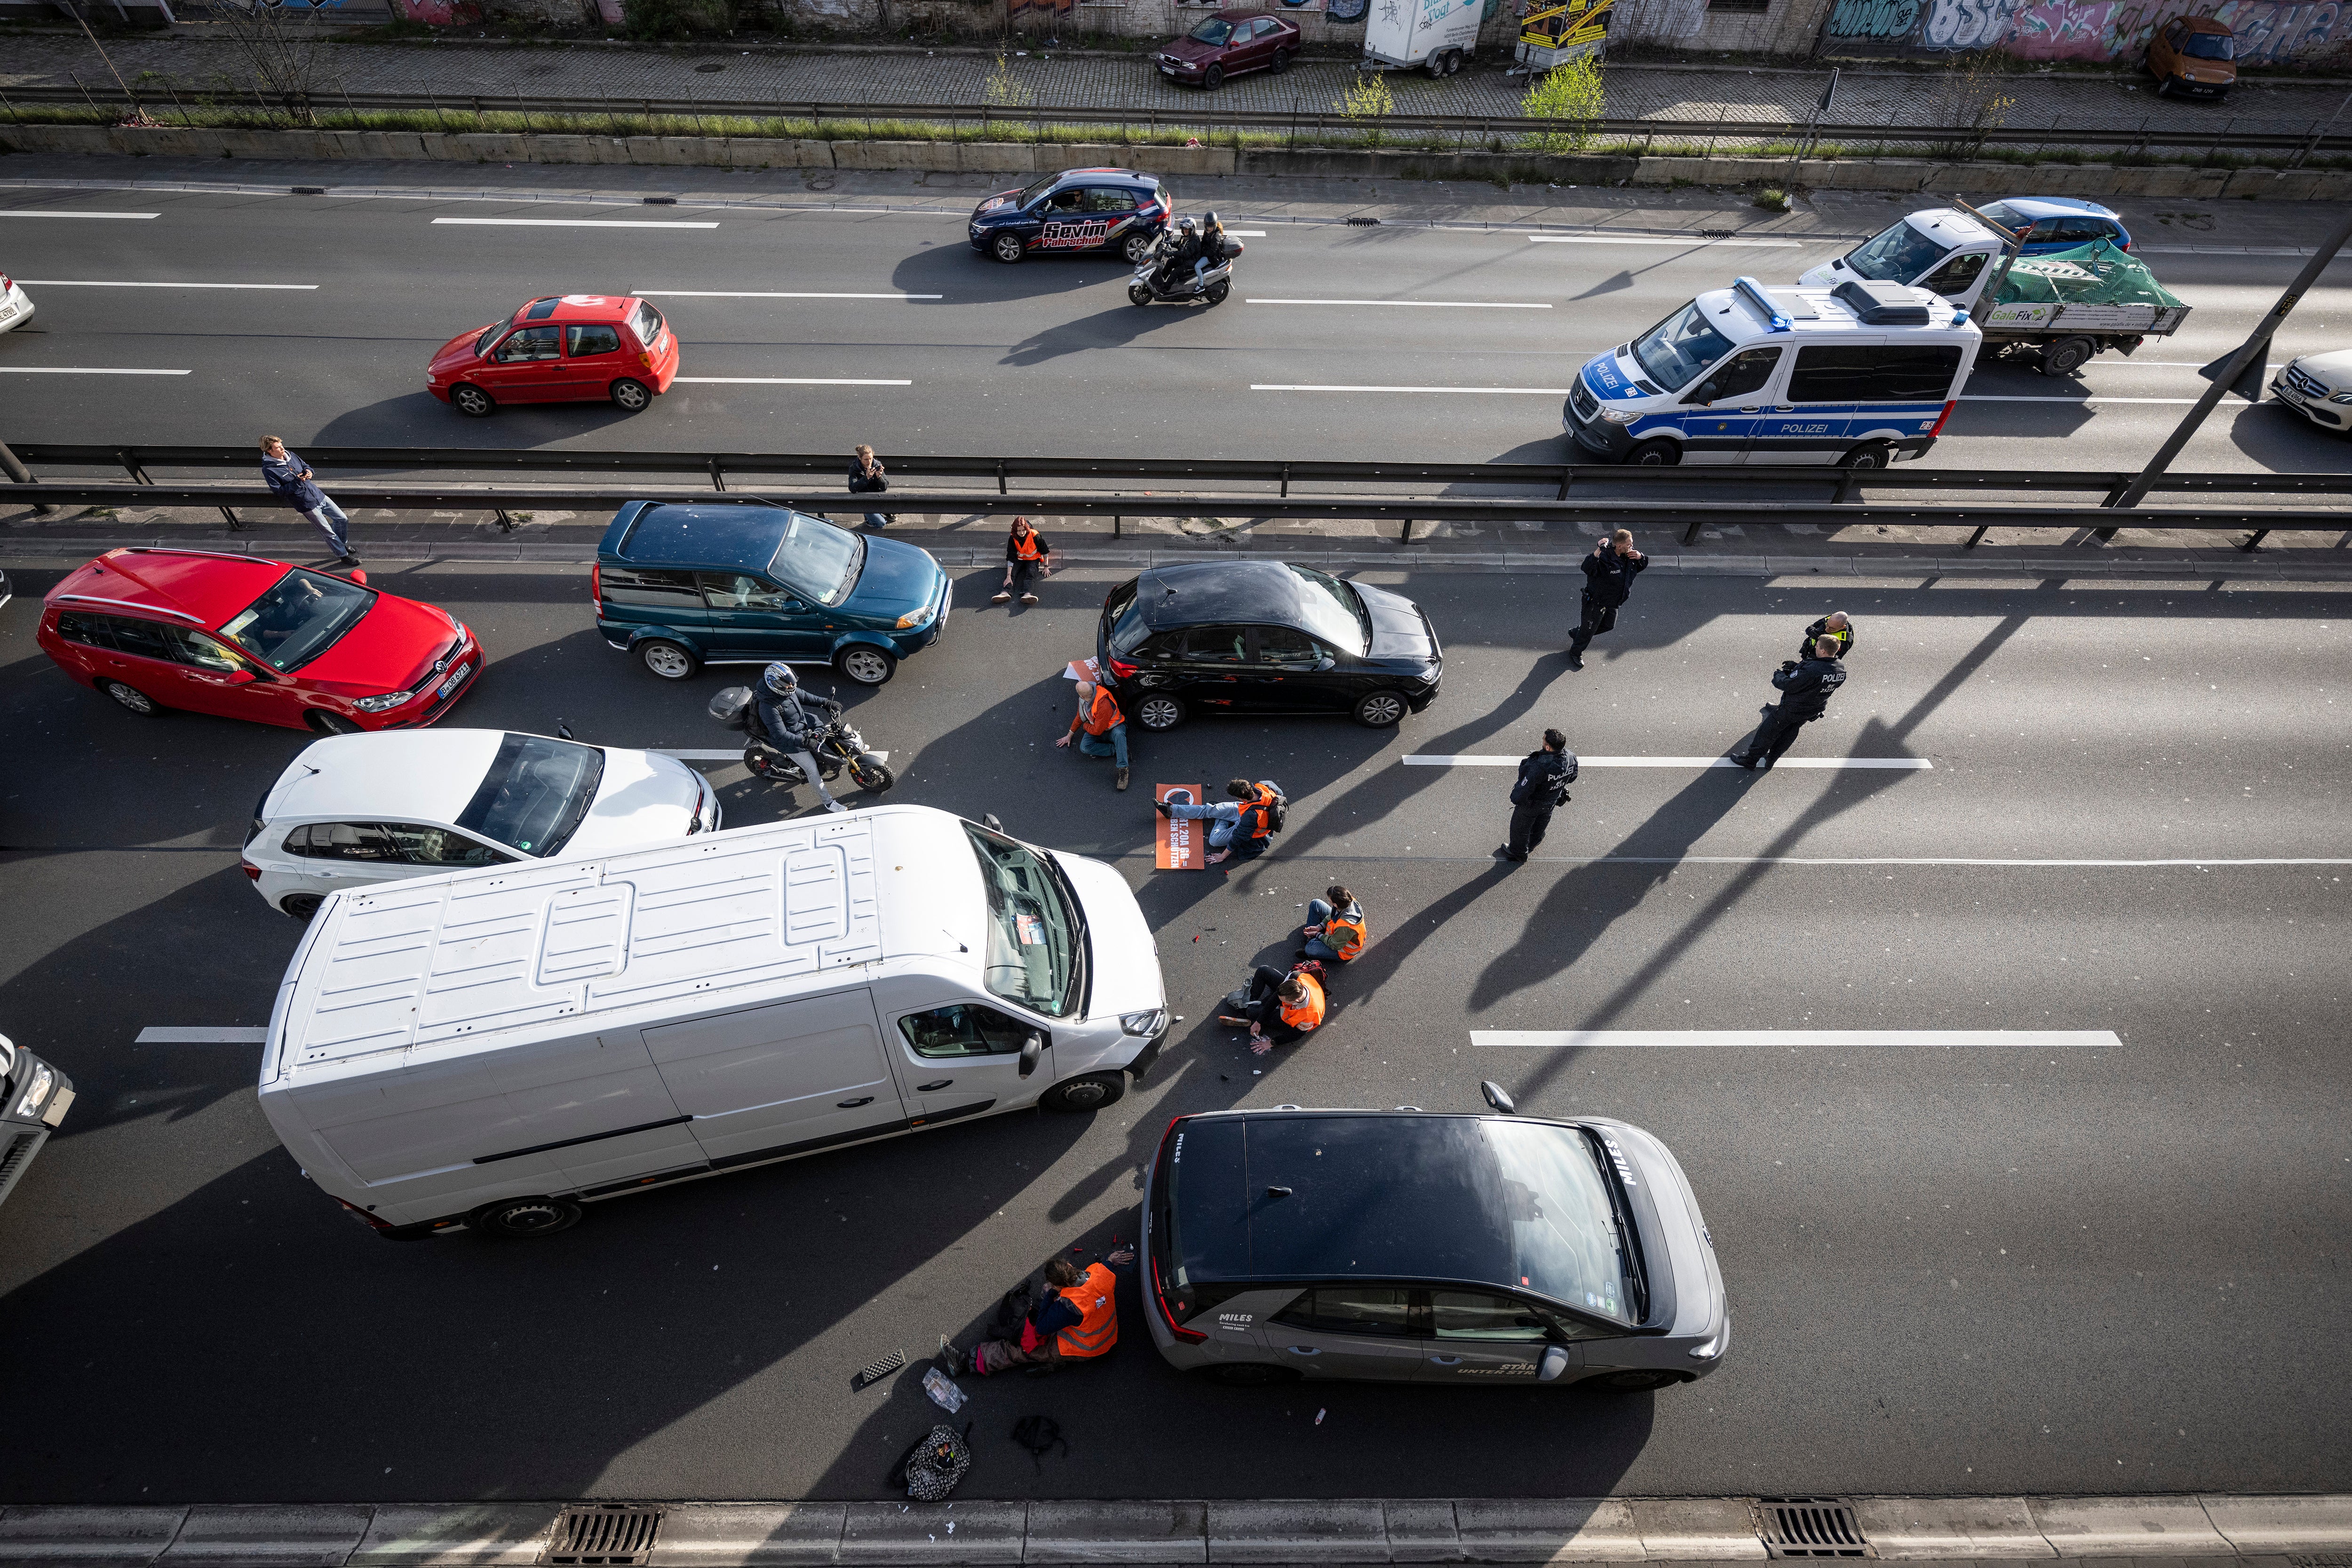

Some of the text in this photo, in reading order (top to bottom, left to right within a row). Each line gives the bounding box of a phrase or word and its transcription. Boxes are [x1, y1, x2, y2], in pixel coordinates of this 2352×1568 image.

[1043, 220, 1108, 240] Sevim
[3, 308, 15, 317] 4789
[1992, 310, 2033, 321] GalaFix
[1594, 362, 1620, 390] POLIZEI
[1626, 388, 1637, 397] 25
[2291, 393, 2303, 402] 4966
[1780, 424, 1829, 433] POLIZEI
[448, 677, 456, 687] OB
[455, 664, 469, 680] 6711
[1821, 673, 1846, 683] POLIZEI
[1548, 766, 1574, 781] POLIZEI
[1179, 818, 1189, 828] RT.
[1179, 829, 1189, 846] 20A
[1170, 833, 1180, 868] SCHÜTZEN
[1180, 847, 1190, 859] GG
[1175, 1133, 1184, 1163] MILES
[1605, 1139, 1637, 1186] MILES
[1219, 1313, 1253, 1322] MILES
